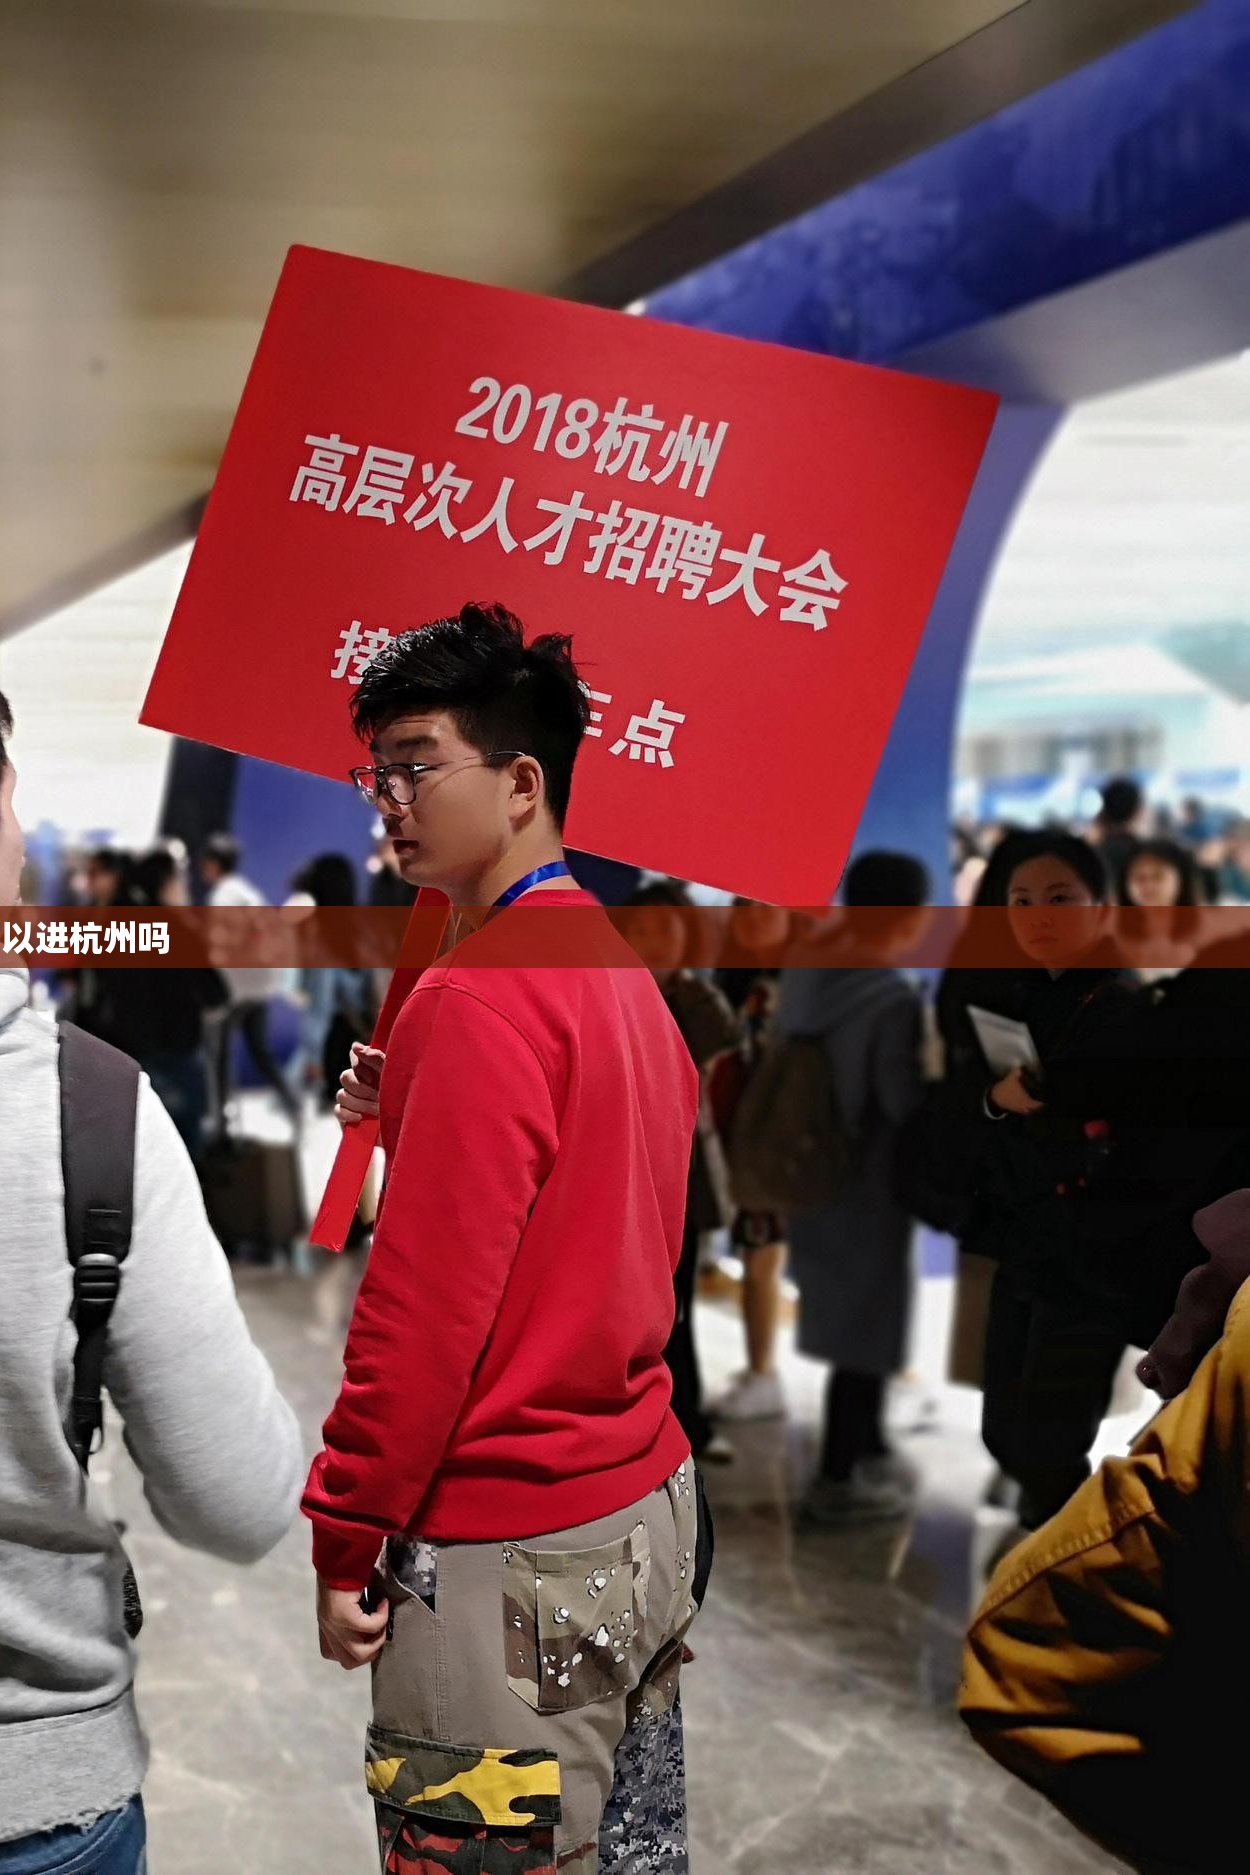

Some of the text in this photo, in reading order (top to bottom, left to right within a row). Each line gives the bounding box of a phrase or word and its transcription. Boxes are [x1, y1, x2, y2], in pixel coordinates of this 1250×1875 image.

[454, 375, 730, 498] 2018杭州
[288, 433, 849, 632] 高层次人才招聘大会
